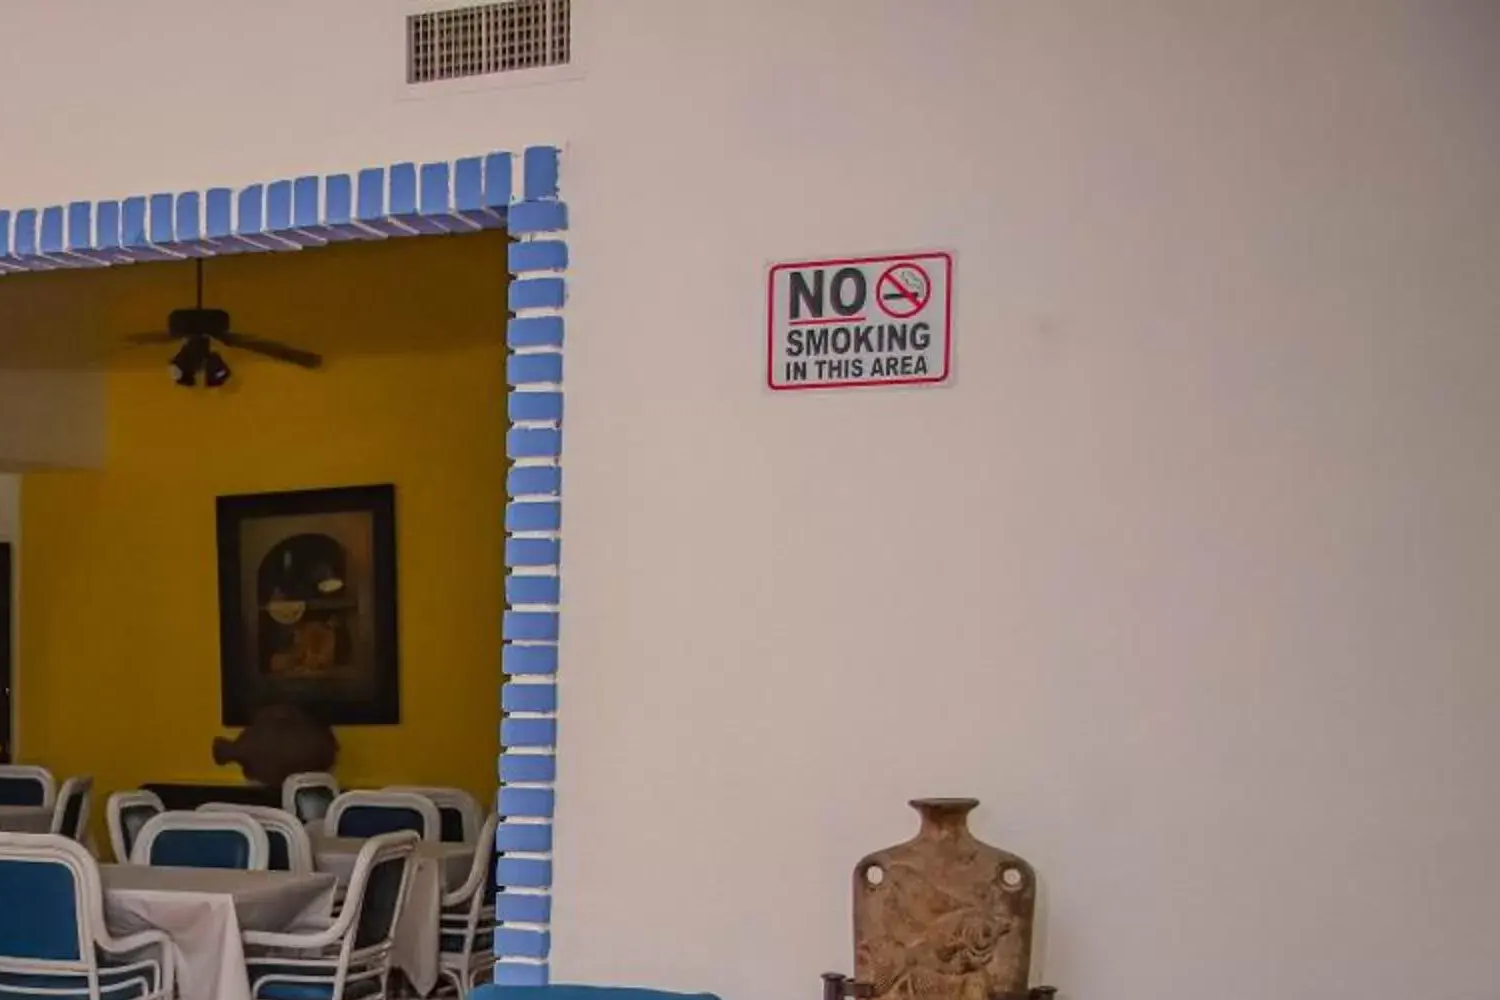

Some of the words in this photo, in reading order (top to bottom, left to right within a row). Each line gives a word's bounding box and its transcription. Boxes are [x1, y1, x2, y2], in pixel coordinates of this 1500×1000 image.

[789, 267, 867, 319] NO
[786, 322, 931, 357] SMOKING
[786, 361, 807, 381] IN
[815, 358, 863, 379] THIS
[870, 355, 928, 377] AREA
